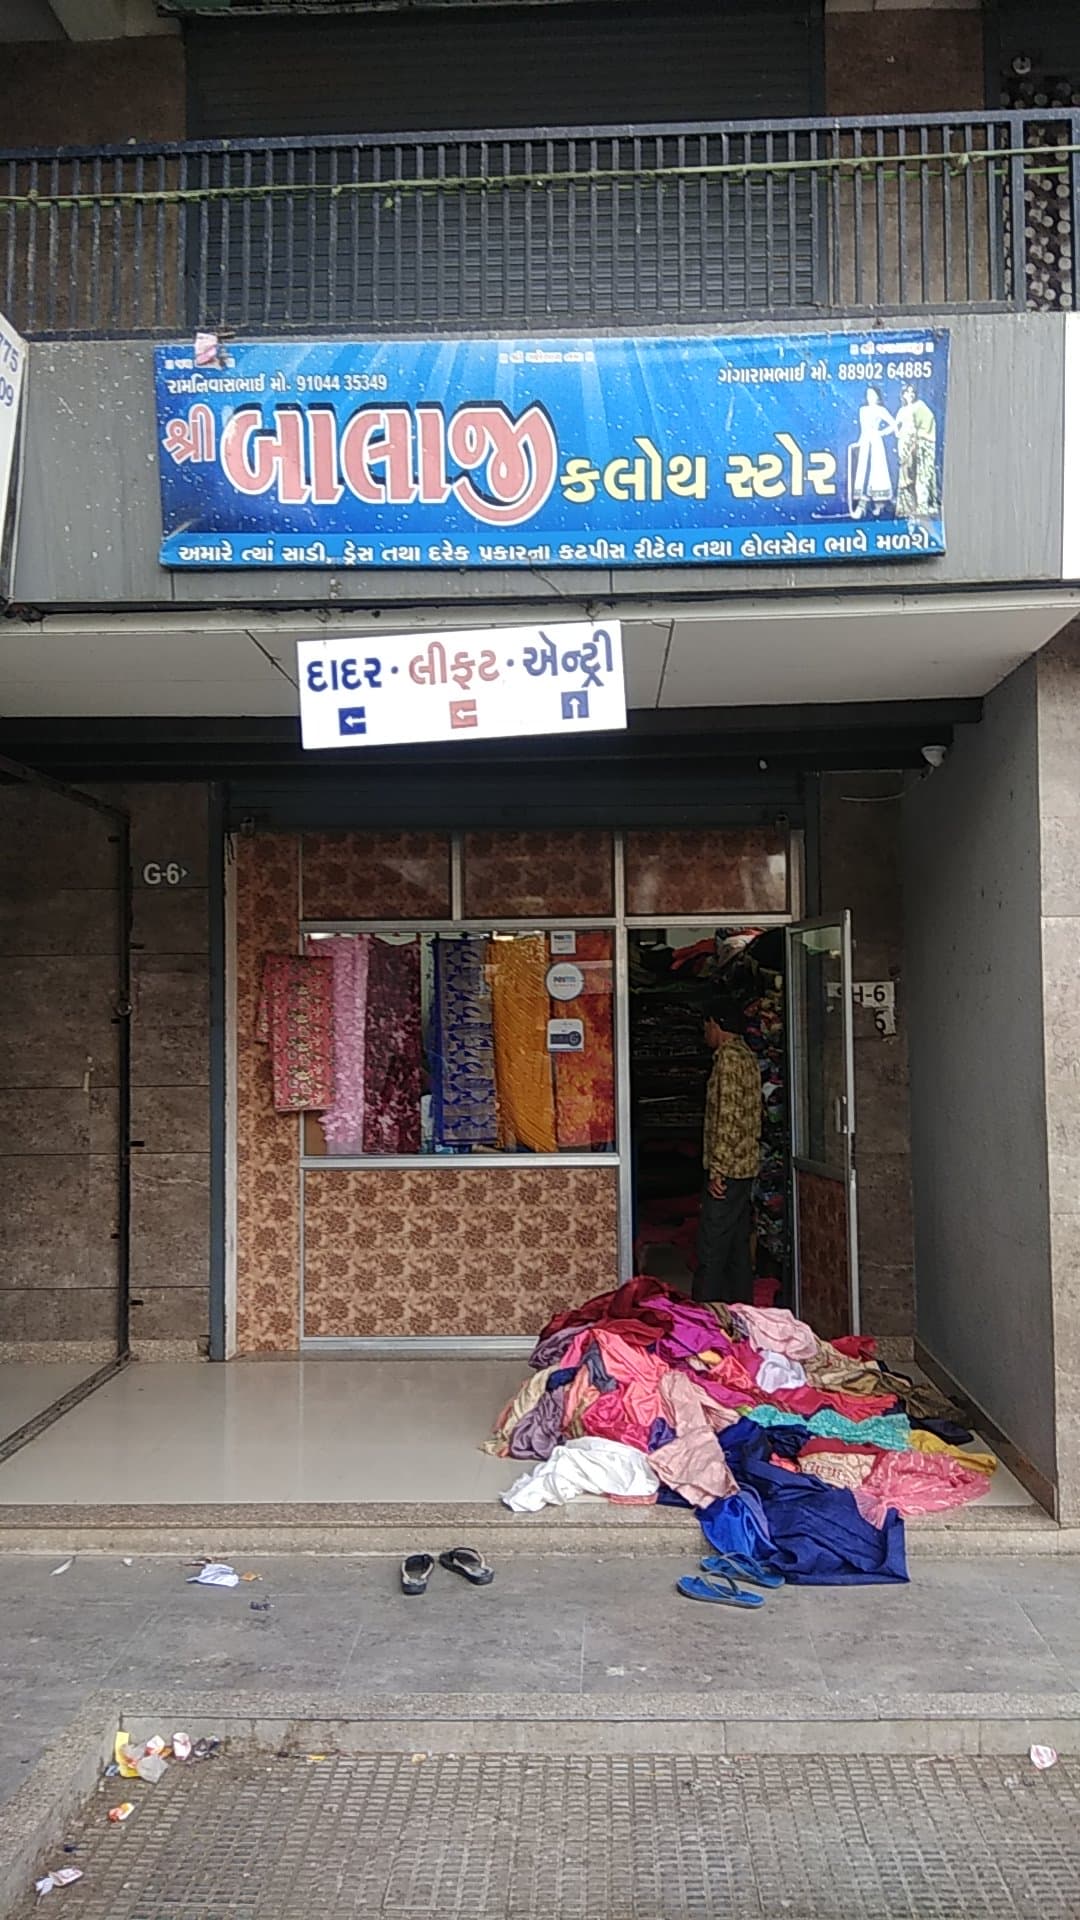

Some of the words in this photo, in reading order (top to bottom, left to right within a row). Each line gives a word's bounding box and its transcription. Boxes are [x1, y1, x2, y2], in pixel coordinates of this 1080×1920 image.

[296, 374, 340, 391] 91044
[344, 373, 388, 391] 35349
[838, 363, 883, 381] 88902
[887, 361, 932, 379] 64885
[162, 403, 216, 465] શ્રી
[220, 404, 558, 527] બાલાજી
[559, 436, 707, 504] કલોથ
[725, 432, 837, 498] સ્ટોર
[178, 540, 233, 562] અમારે
[241, 539, 274, 562] ત્યાં
[341, 540, 373, 565] ડ્રેસ
[381, 545, 420, 562] તથા
[428, 540, 469, 561] દરેક
[478, 545, 550, 562] પ્રકારના
[559, 537, 626, 560] કટપીસ
[633, 536, 684, 559] રીટેલ
[692, 539, 732, 557] તથા
[740, 532, 815, 558] હોલસેલ
[824, 528, 868, 553] ભાવે
[306, 656, 383, 693] દાદર
[522, 630, 614, 688] એન્ટ્રી
[143, 862, 180, 885] G-6
[837, 984, 886, 1003] H-6
